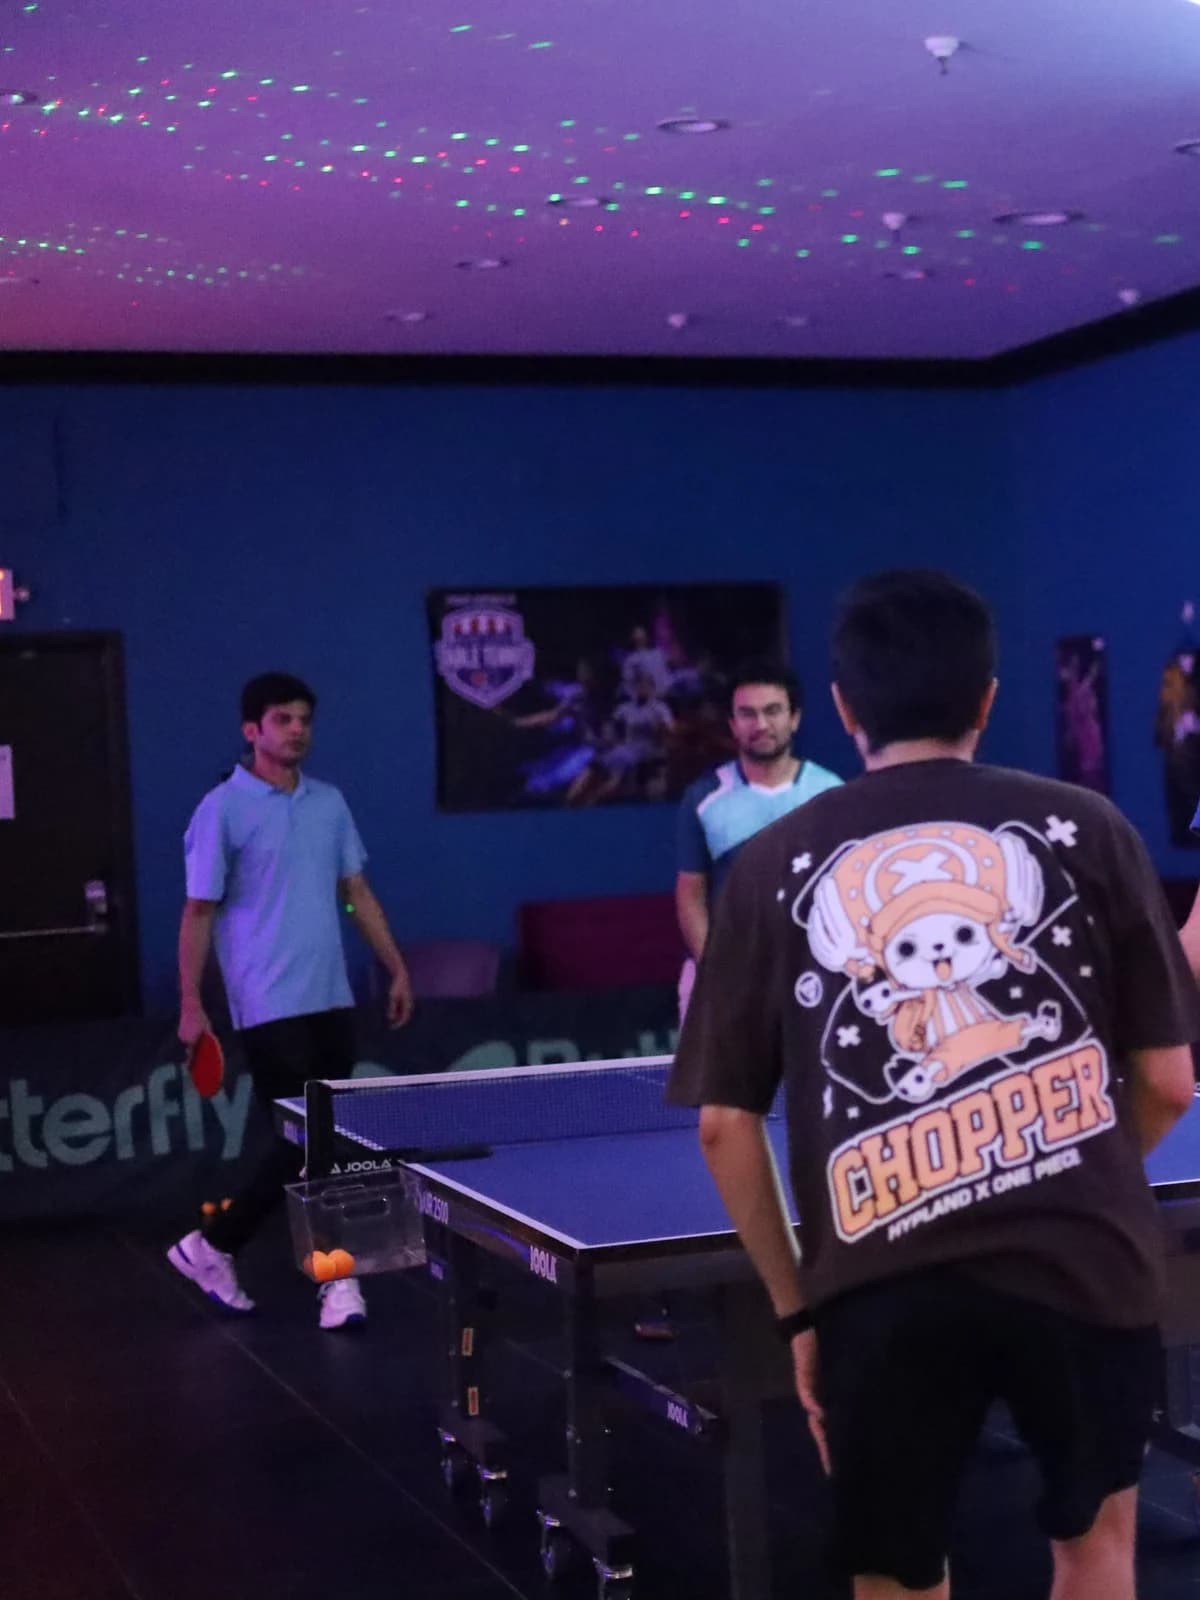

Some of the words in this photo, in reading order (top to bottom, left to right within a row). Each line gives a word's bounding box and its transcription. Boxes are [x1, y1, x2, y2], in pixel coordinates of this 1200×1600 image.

[344, 1159, 392, 1173] JOOLA
[829, 1039, 1115, 1242] CHOPPER
[887, 1188, 972, 1242] HYPLAND
[974, 1181, 991, 1201] X
[992, 1165, 1032, 1194] ONE
[530, 1245, 557, 1284] JOOLA
